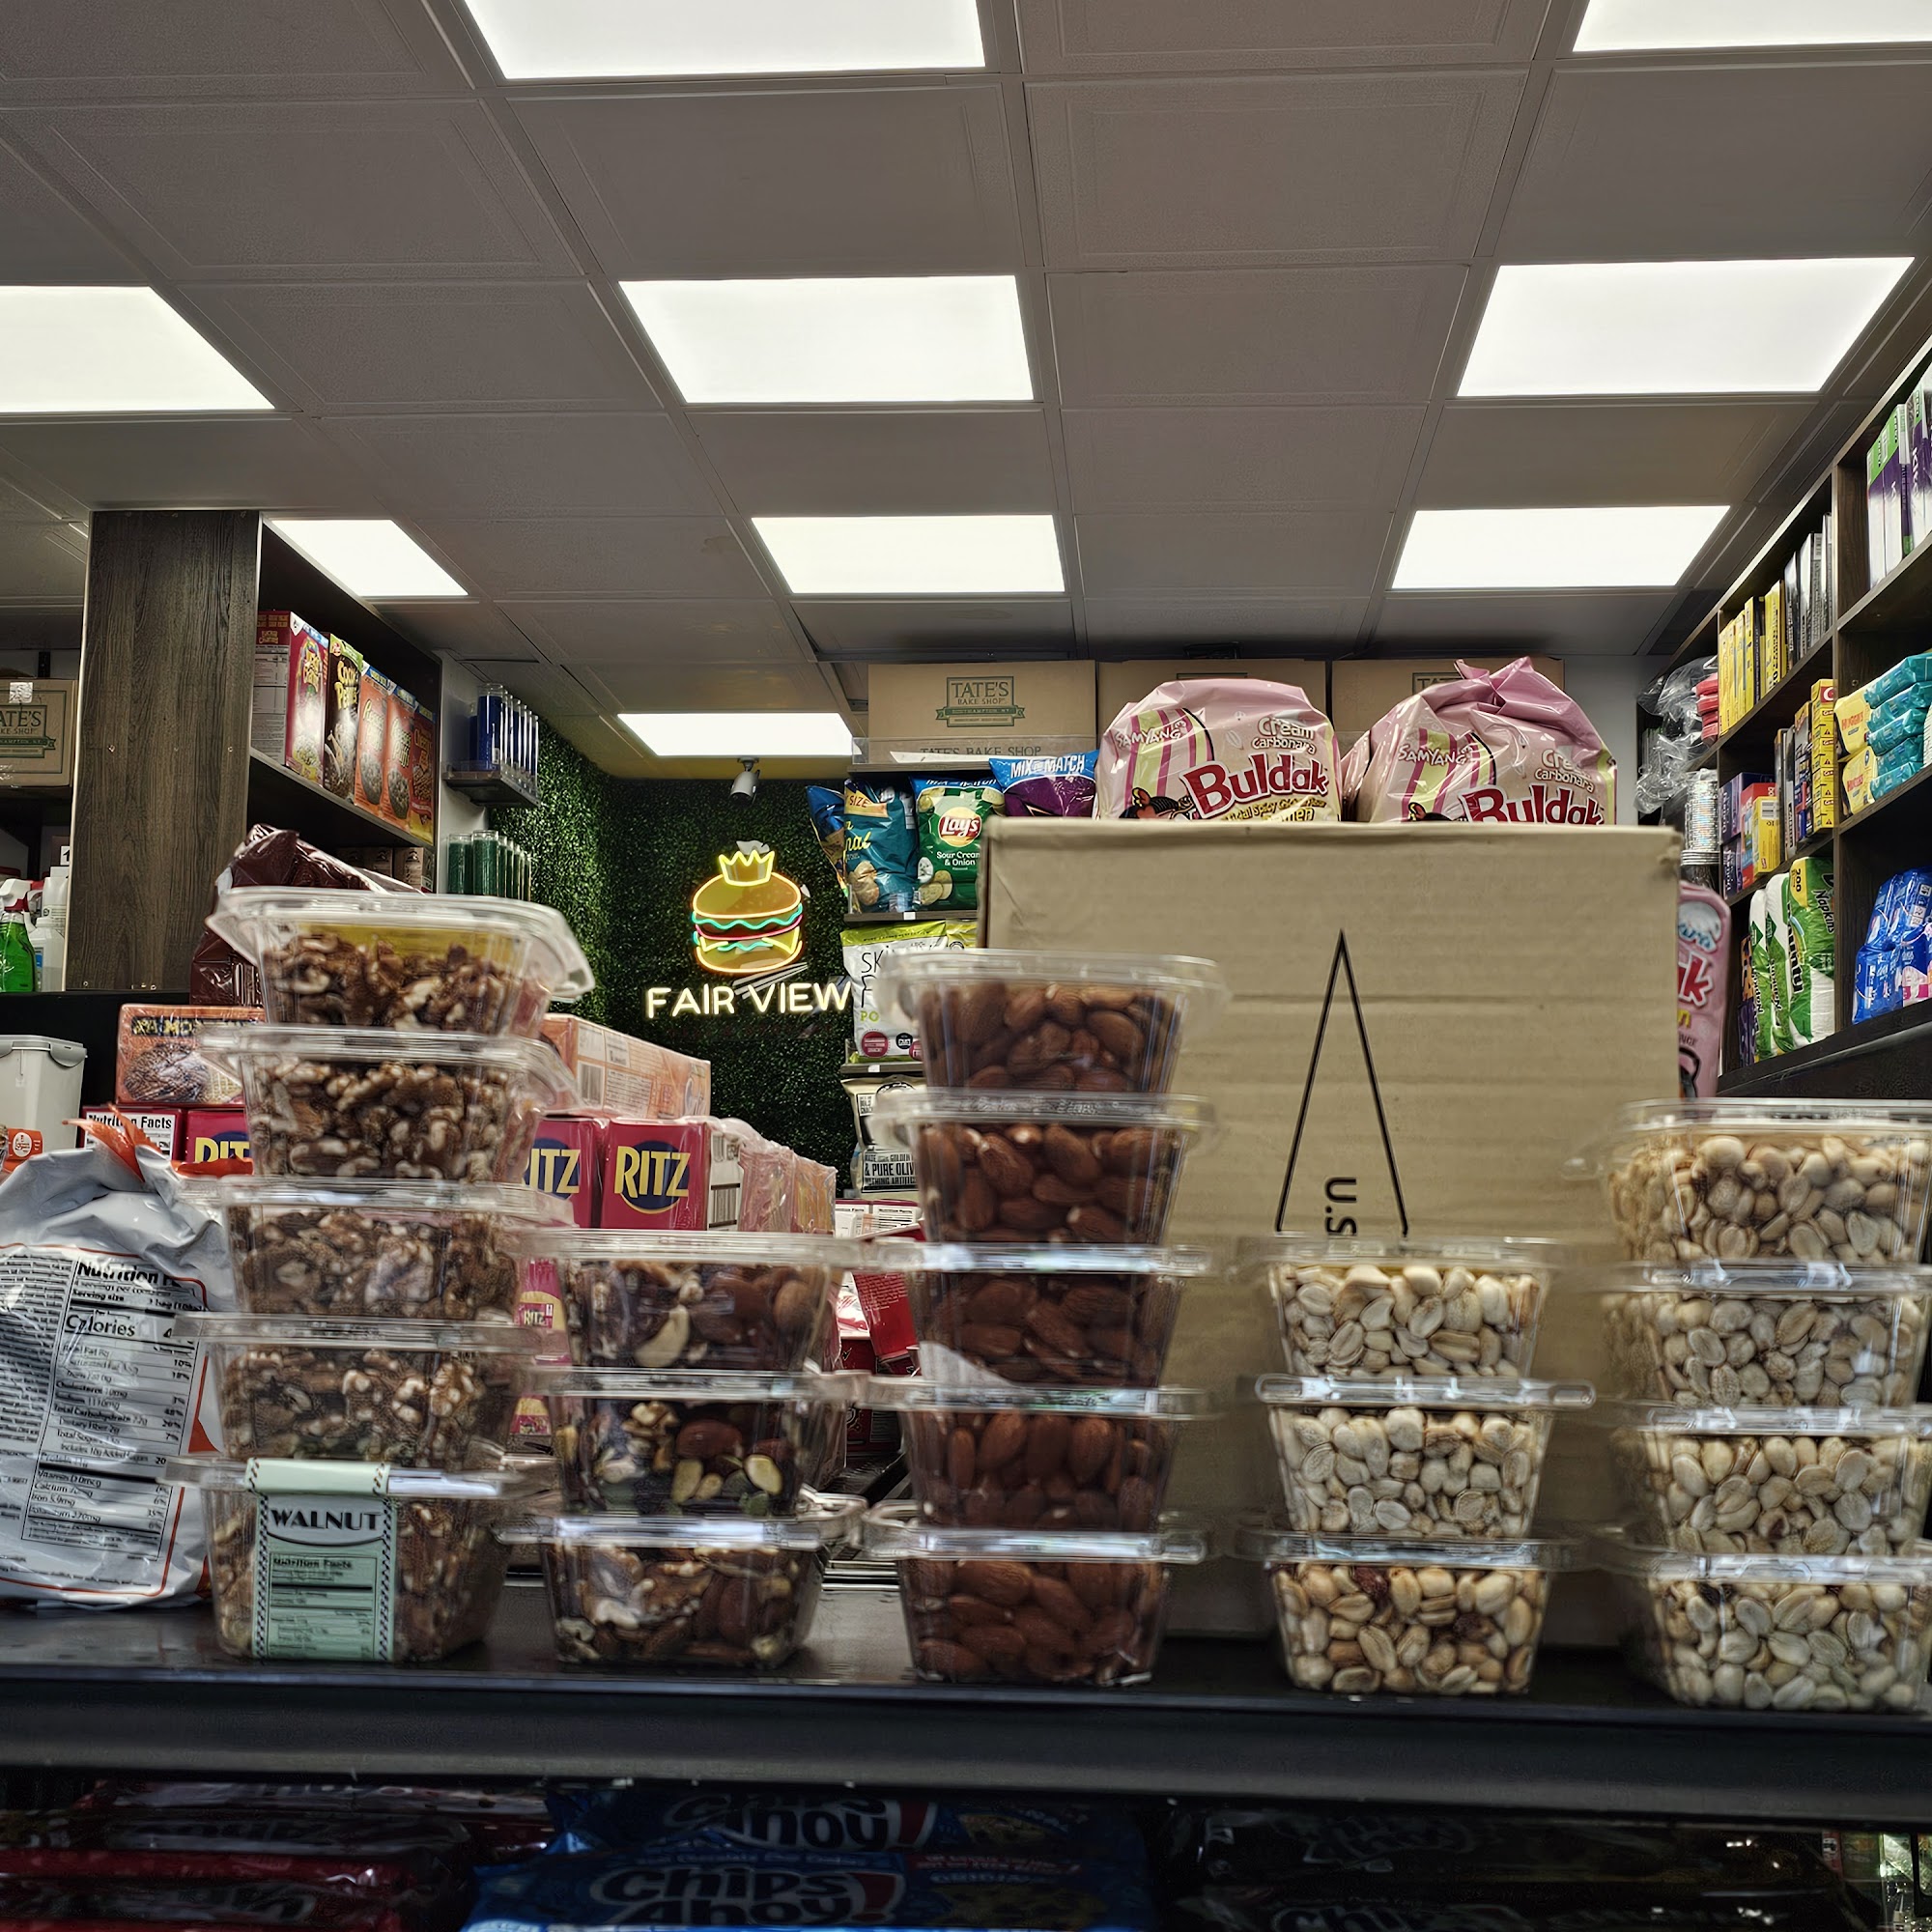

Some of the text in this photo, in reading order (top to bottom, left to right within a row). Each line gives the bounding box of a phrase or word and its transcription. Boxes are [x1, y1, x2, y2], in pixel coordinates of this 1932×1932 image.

[951, 681, 1009, 697] TATE'S
[0, 710, 42, 726] ATE'S
[1258, 716, 1315, 741] Cream
[1115, 725, 1179, 748] SAMYANG
[966, 747, 1001, 755] BAKE
[1009, 746, 1041, 756] SHOP
[1398, 744, 1467, 765] SAMYANG
[1009, 760, 1032, 779] MIX
[1044, 754, 1086, 774] MATCH
[1179, 751, 1331, 819] Buldak
[849, 794, 870, 809] SIZE
[646, 983, 735, 1019] FAIR
[747, 980, 852, 1015] VIEW
[141, 1116, 172, 1129] Facts
[529, 1148, 582, 1194] ITZ
[614, 1146, 692, 1199] RITZ
[865, 1161, 915, 1177] & PURE OLIV
[72, 1289, 125, 1302] Serving size
[66, 1314, 135, 1337] Calories
[35, 1481, 68, 1492] Calcium
[270, 1508, 382, 1531] WALNUT
[595, 1865, 852, 1902] Chips
